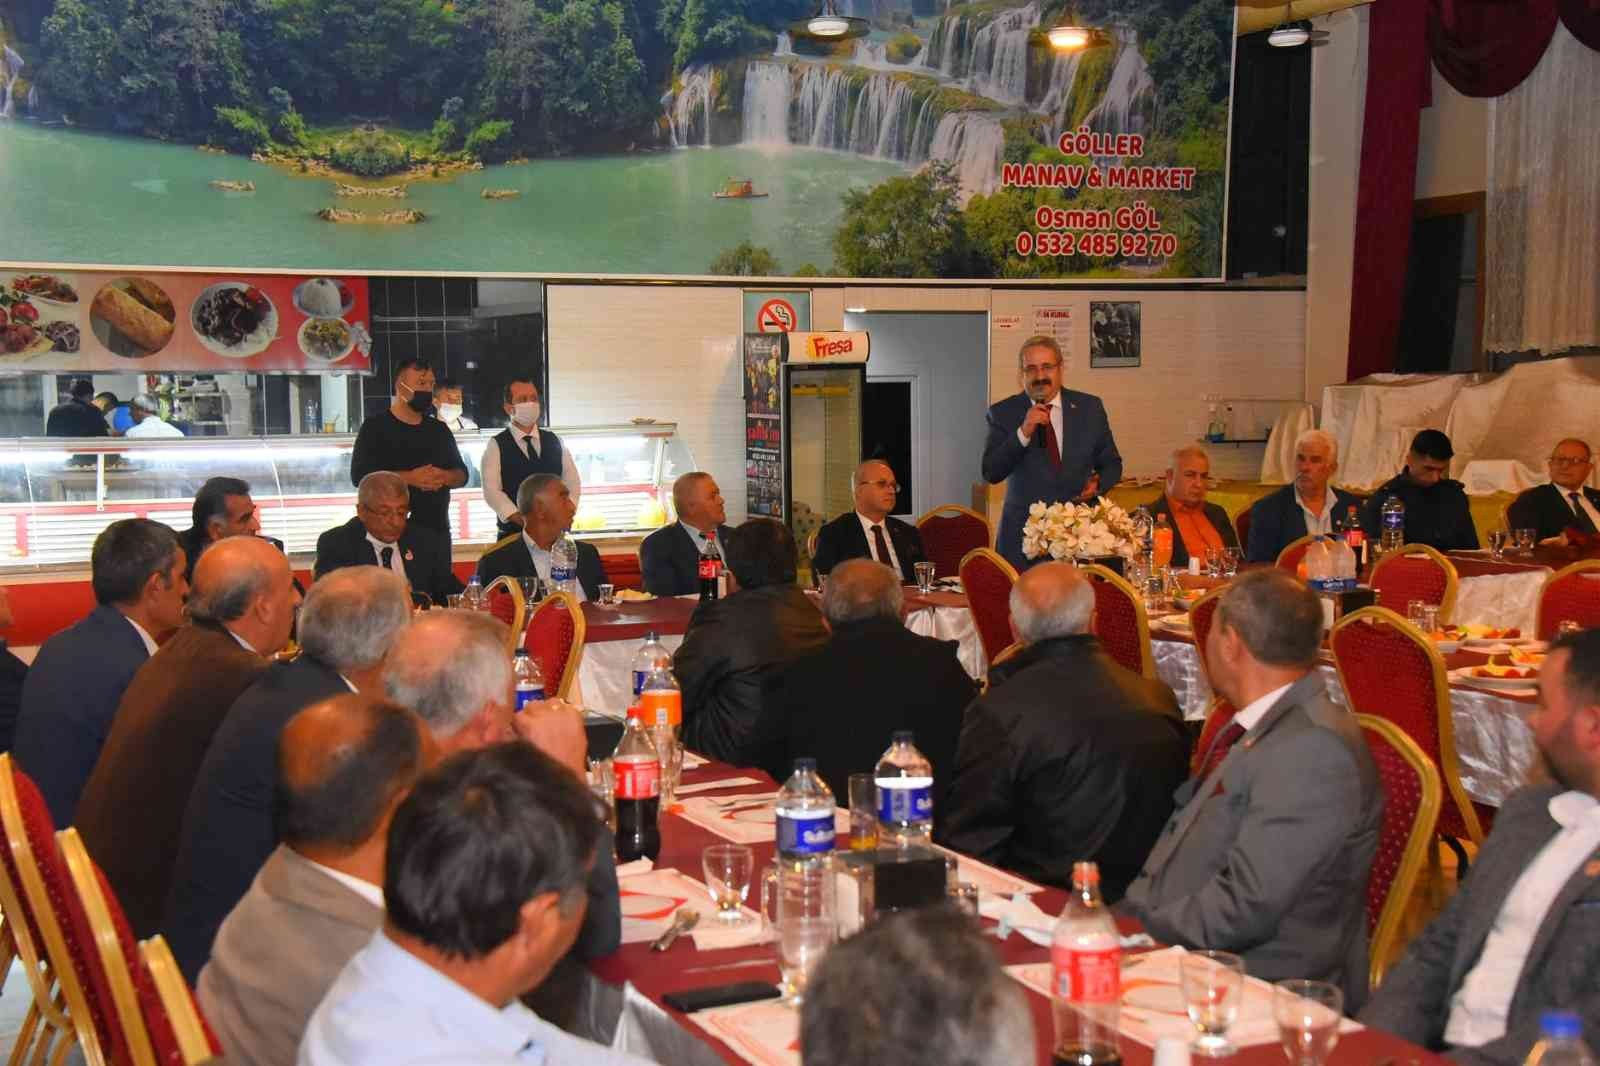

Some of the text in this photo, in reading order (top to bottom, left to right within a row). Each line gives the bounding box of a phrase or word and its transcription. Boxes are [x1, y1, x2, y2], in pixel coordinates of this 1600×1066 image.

[1059, 126, 1143, 156] GÖLLER
[1002, 164, 1195, 189] MANAV & MARKET
[1036, 201, 1160, 229] Osman GÖL
[1016, 233, 1176, 255] 0 532 485 92 70
